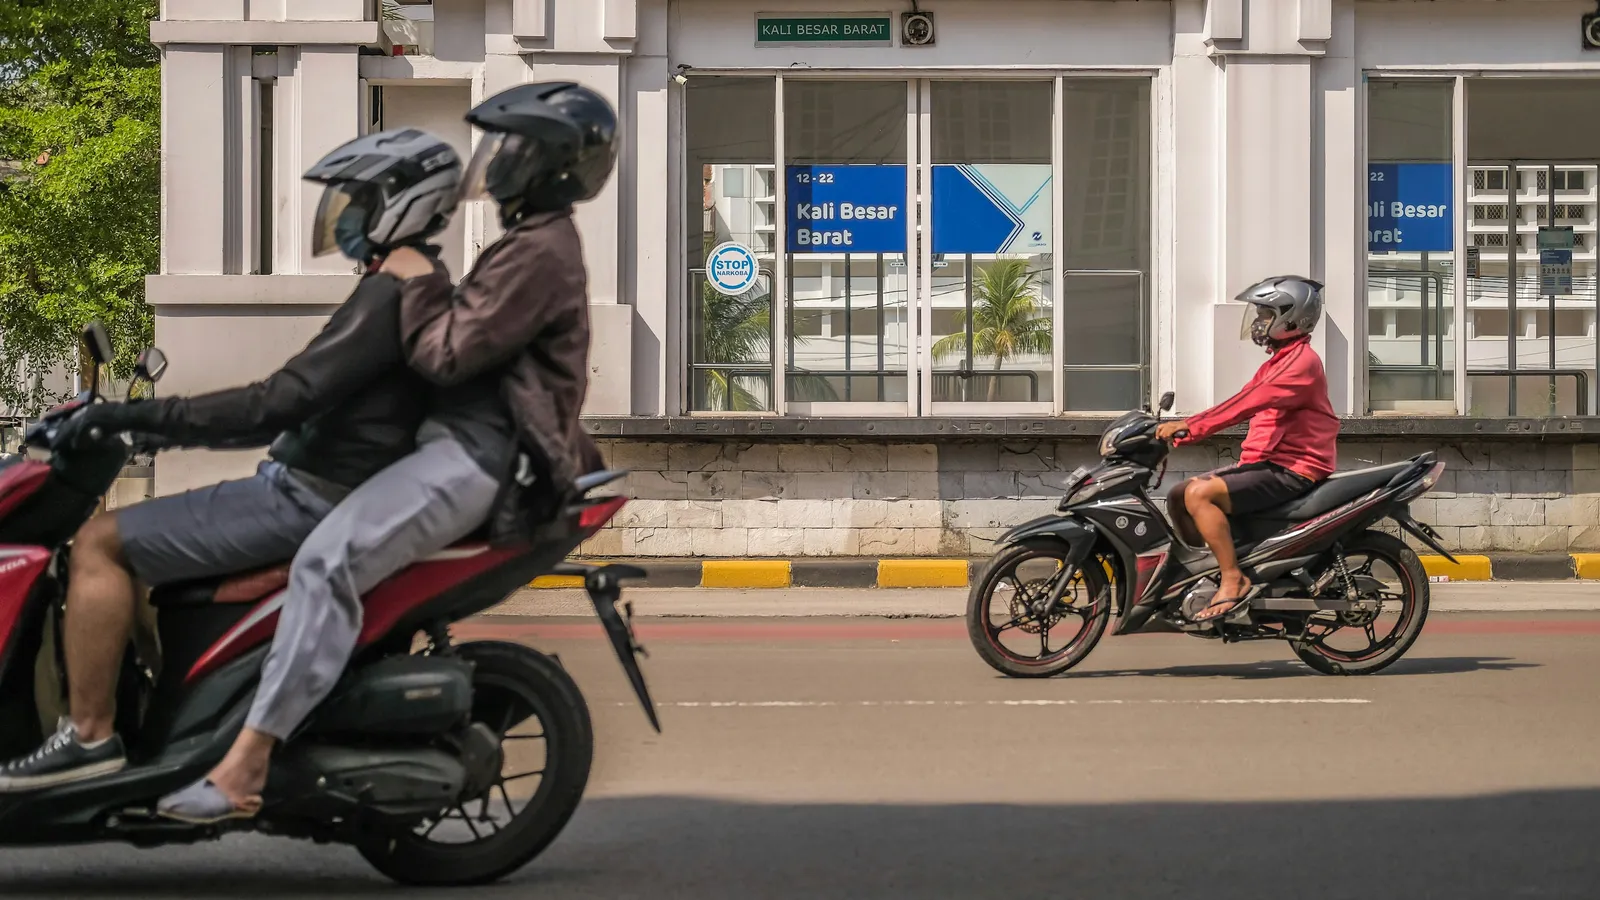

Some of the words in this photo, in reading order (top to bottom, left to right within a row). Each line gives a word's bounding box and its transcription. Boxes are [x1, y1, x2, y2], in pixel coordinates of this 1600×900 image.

[762, 24, 792, 35] KALI
[796, 24, 839, 35] BESAR
[843, 24, 885, 35] BARAT
[796, 173, 810, 183] 12
[819, 173, 834, 183] 22
[1370, 172, 1384, 182] 22
[797, 202, 834, 220] Kali
[840, 202, 898, 220] Besar
[1390, 201, 1447, 218] Besar
[797, 228, 853, 245] Barat
[716, 260, 749, 270] STOP
